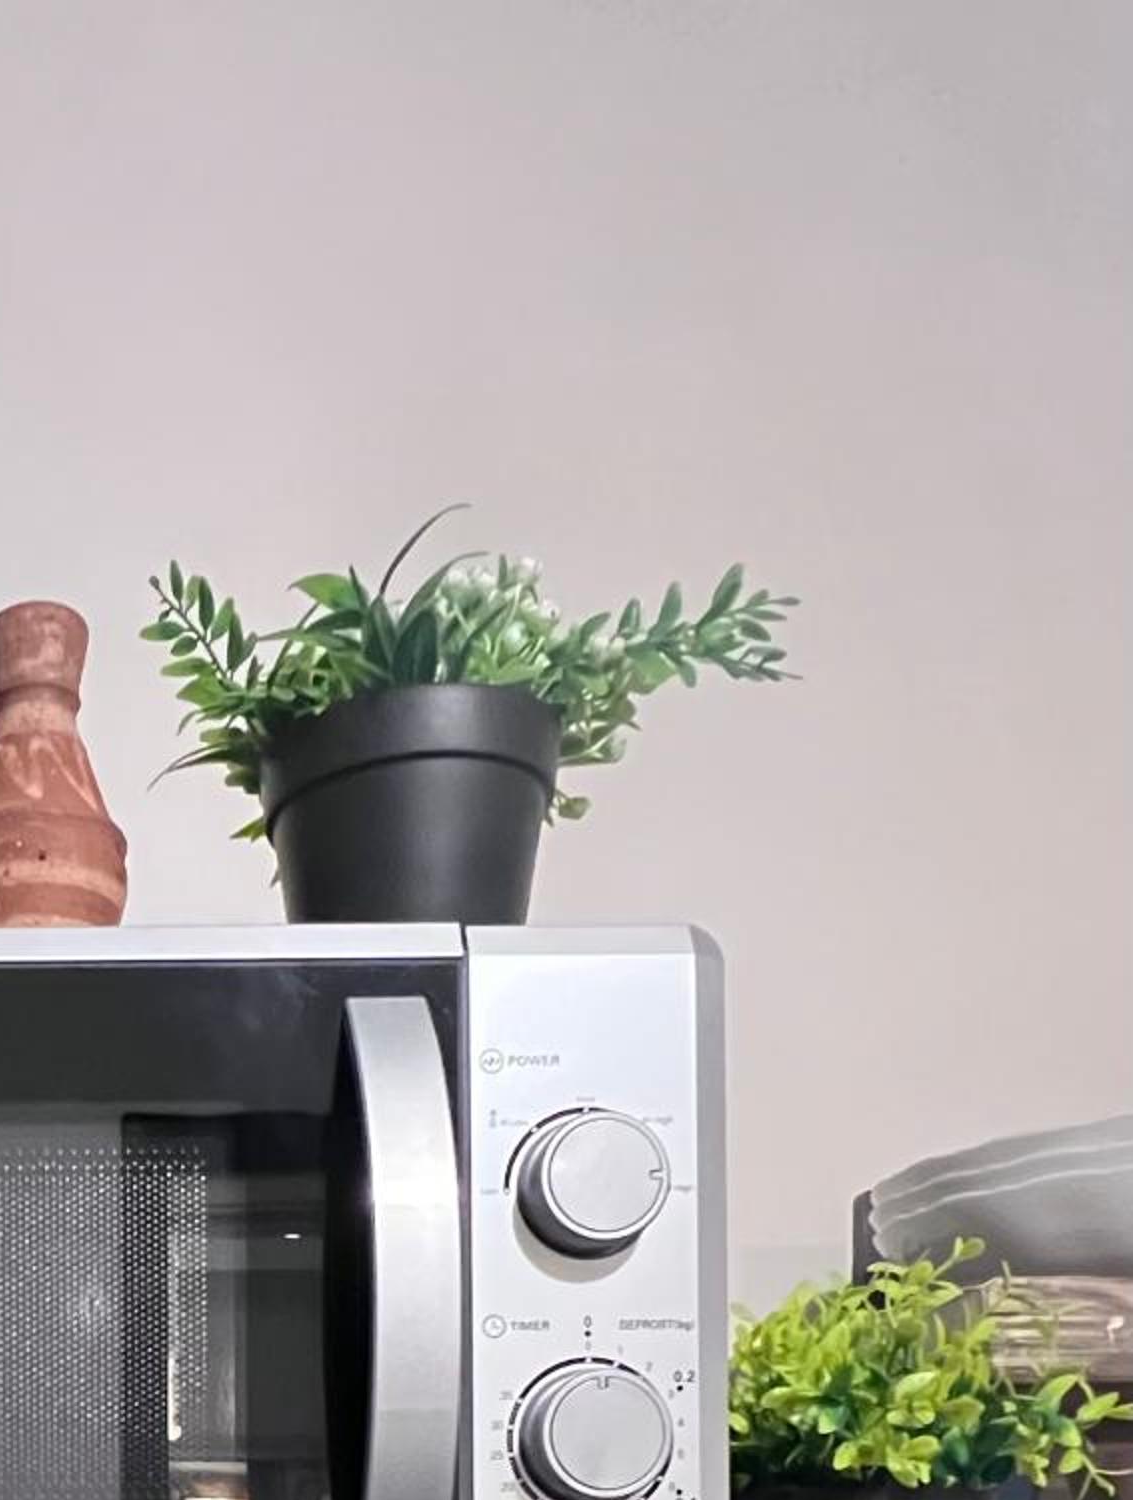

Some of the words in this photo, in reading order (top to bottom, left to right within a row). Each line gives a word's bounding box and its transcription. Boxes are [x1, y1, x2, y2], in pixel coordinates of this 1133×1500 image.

[506, 1055, 561, 1067] POWER
[510, 1320, 550, 1331] TIMER
[583, 1315, 592, 1328] 0
[673, 1370, 696, 1383] 0.2
